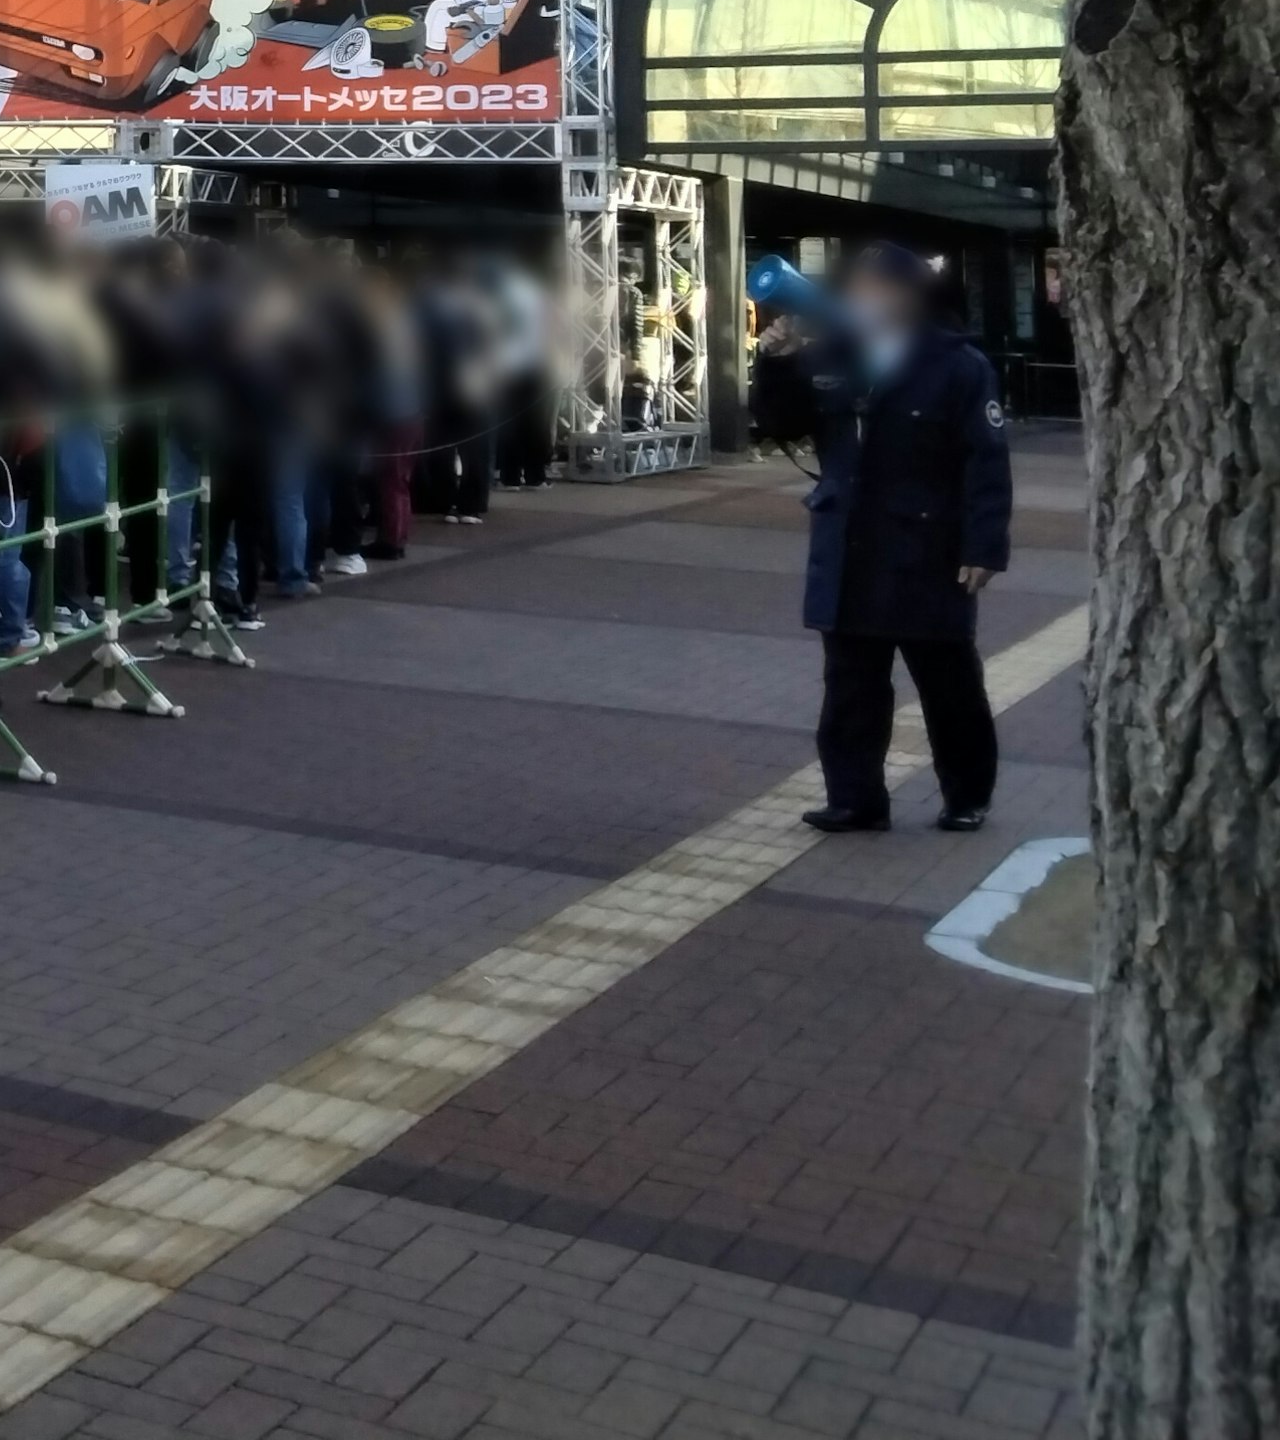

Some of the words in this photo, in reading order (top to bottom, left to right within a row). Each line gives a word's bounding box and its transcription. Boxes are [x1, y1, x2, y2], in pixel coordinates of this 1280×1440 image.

[189, 84, 549, 111] 大阪オートメッセ2023
[50, 186, 149, 231] OAM
